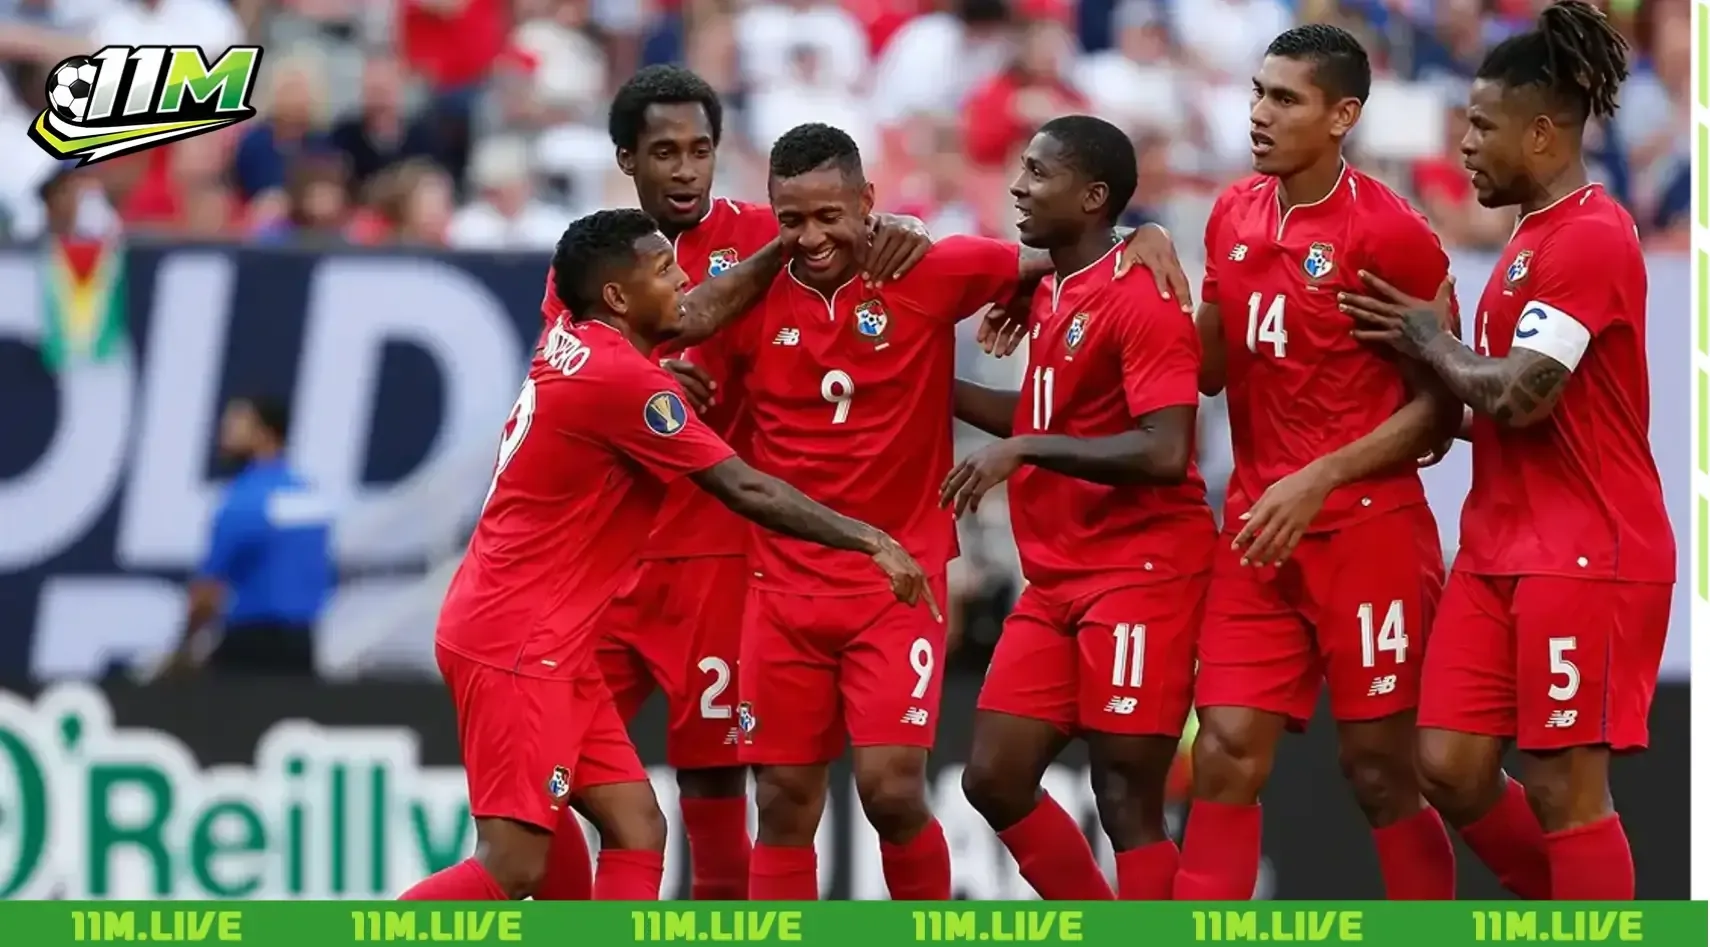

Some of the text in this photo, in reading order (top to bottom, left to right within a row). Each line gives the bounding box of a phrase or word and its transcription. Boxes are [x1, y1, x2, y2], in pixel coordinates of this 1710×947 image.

[1246, 291, 1288, 358] 14
[1516, 307, 1547, 338] C
[821, 369, 854, 424] 9
[1033, 365, 1054, 431] 11
[1112, 622, 1146, 688] 11
[1357, 600, 1409, 667] 14
[698, 656, 740, 719] 2
[909, 637, 934, 699] 9
[1548, 636, 1580, 701] 5
